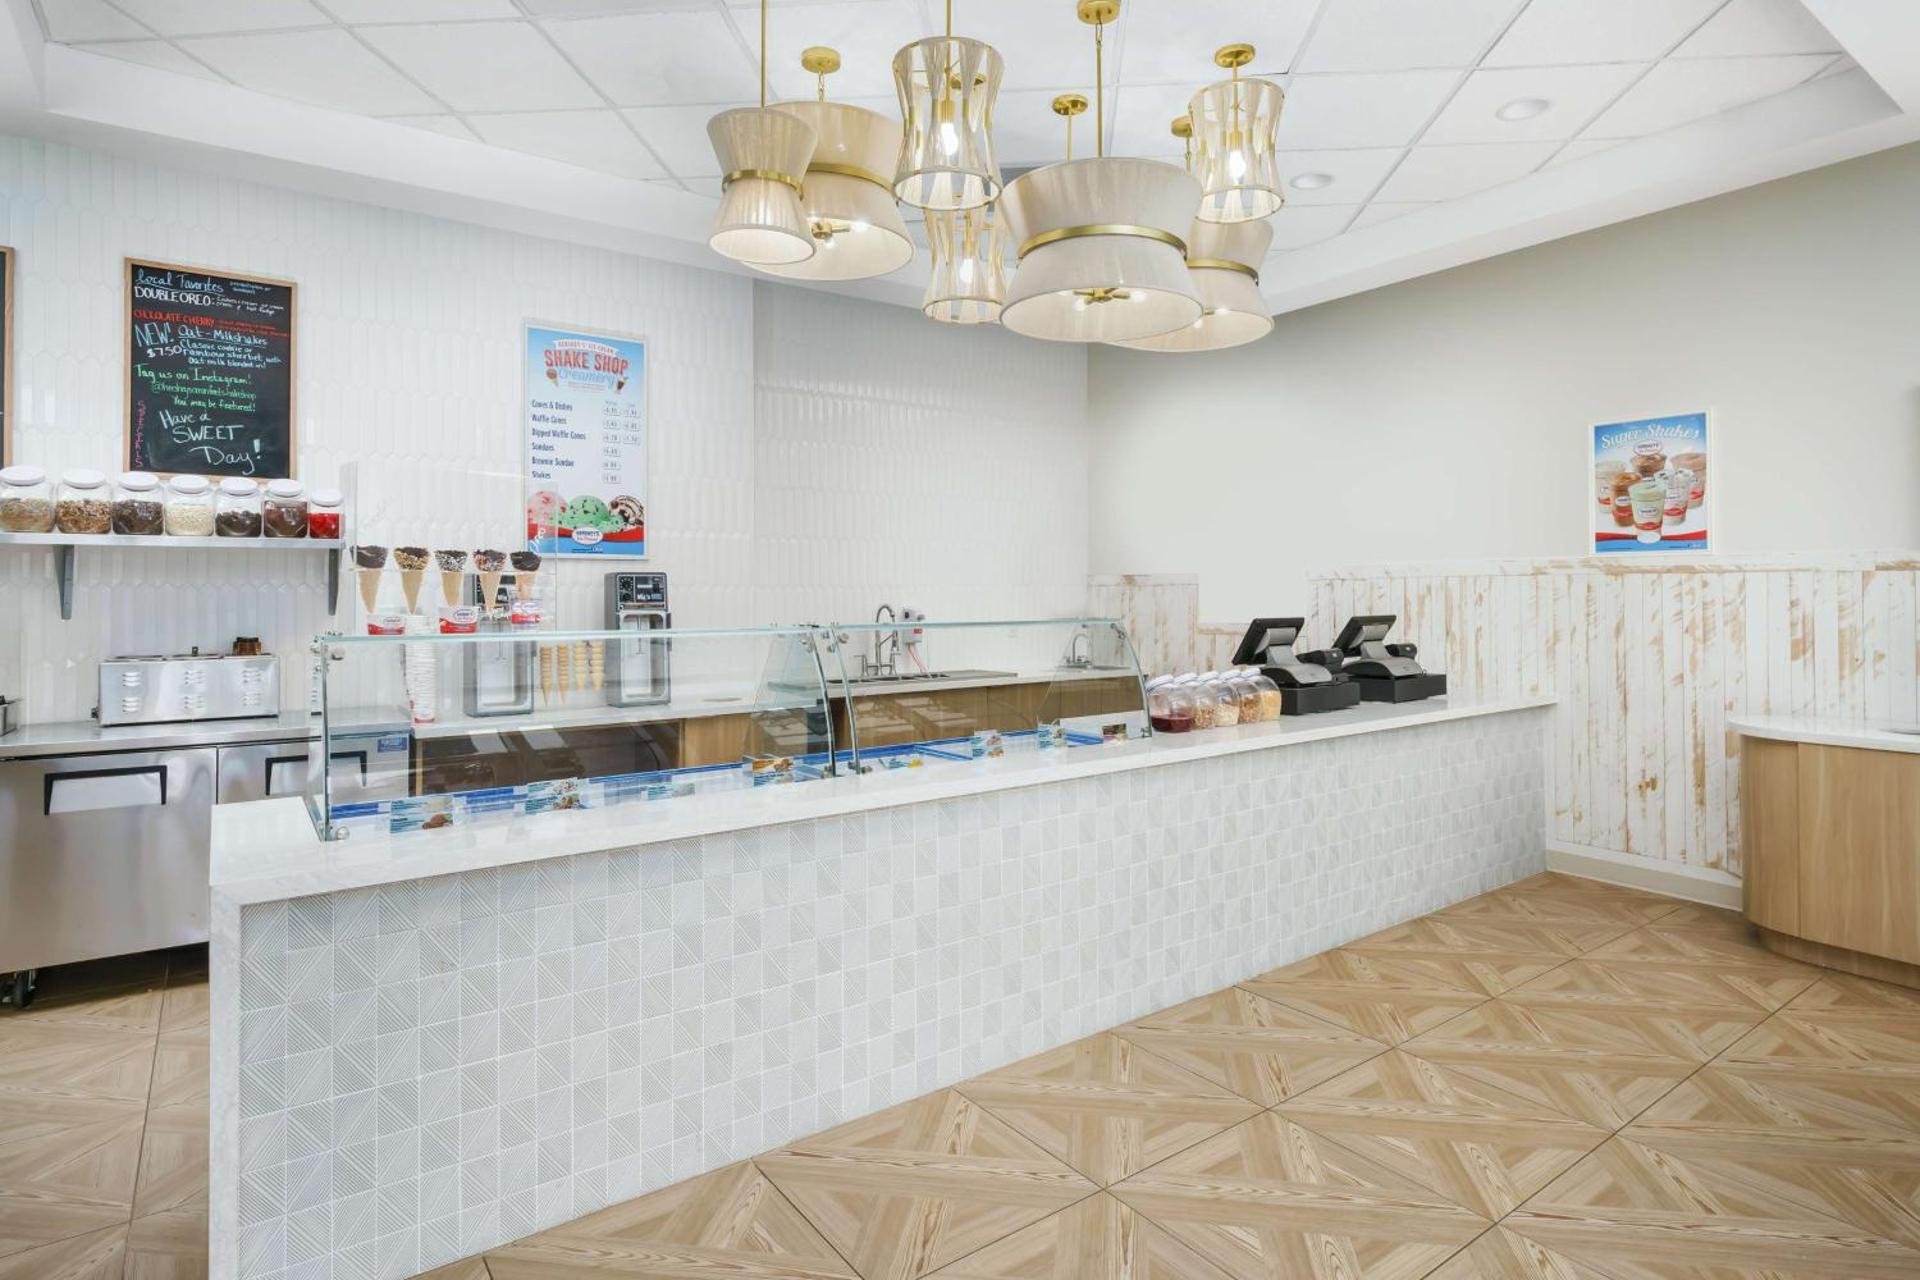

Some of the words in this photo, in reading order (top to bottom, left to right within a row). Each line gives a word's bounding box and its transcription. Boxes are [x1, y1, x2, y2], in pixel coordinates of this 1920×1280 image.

[134, 286, 179, 302] DOUBLE
[180, 292, 211, 306] OREO
[544, 349, 590, 369] SHAKE
[594, 352, 630, 375] SHOP
[133, 363, 156, 384] Tag
[208, 400, 216, 408] be
[159, 409, 196, 429] Have
[200, 412, 211, 421] a
[172, 425, 244, 444] SWEET
[532, 427, 551, 438] Dipped
[1648, 423, 1700, 440] Shakes
[188, 438, 261, 476] Day!
